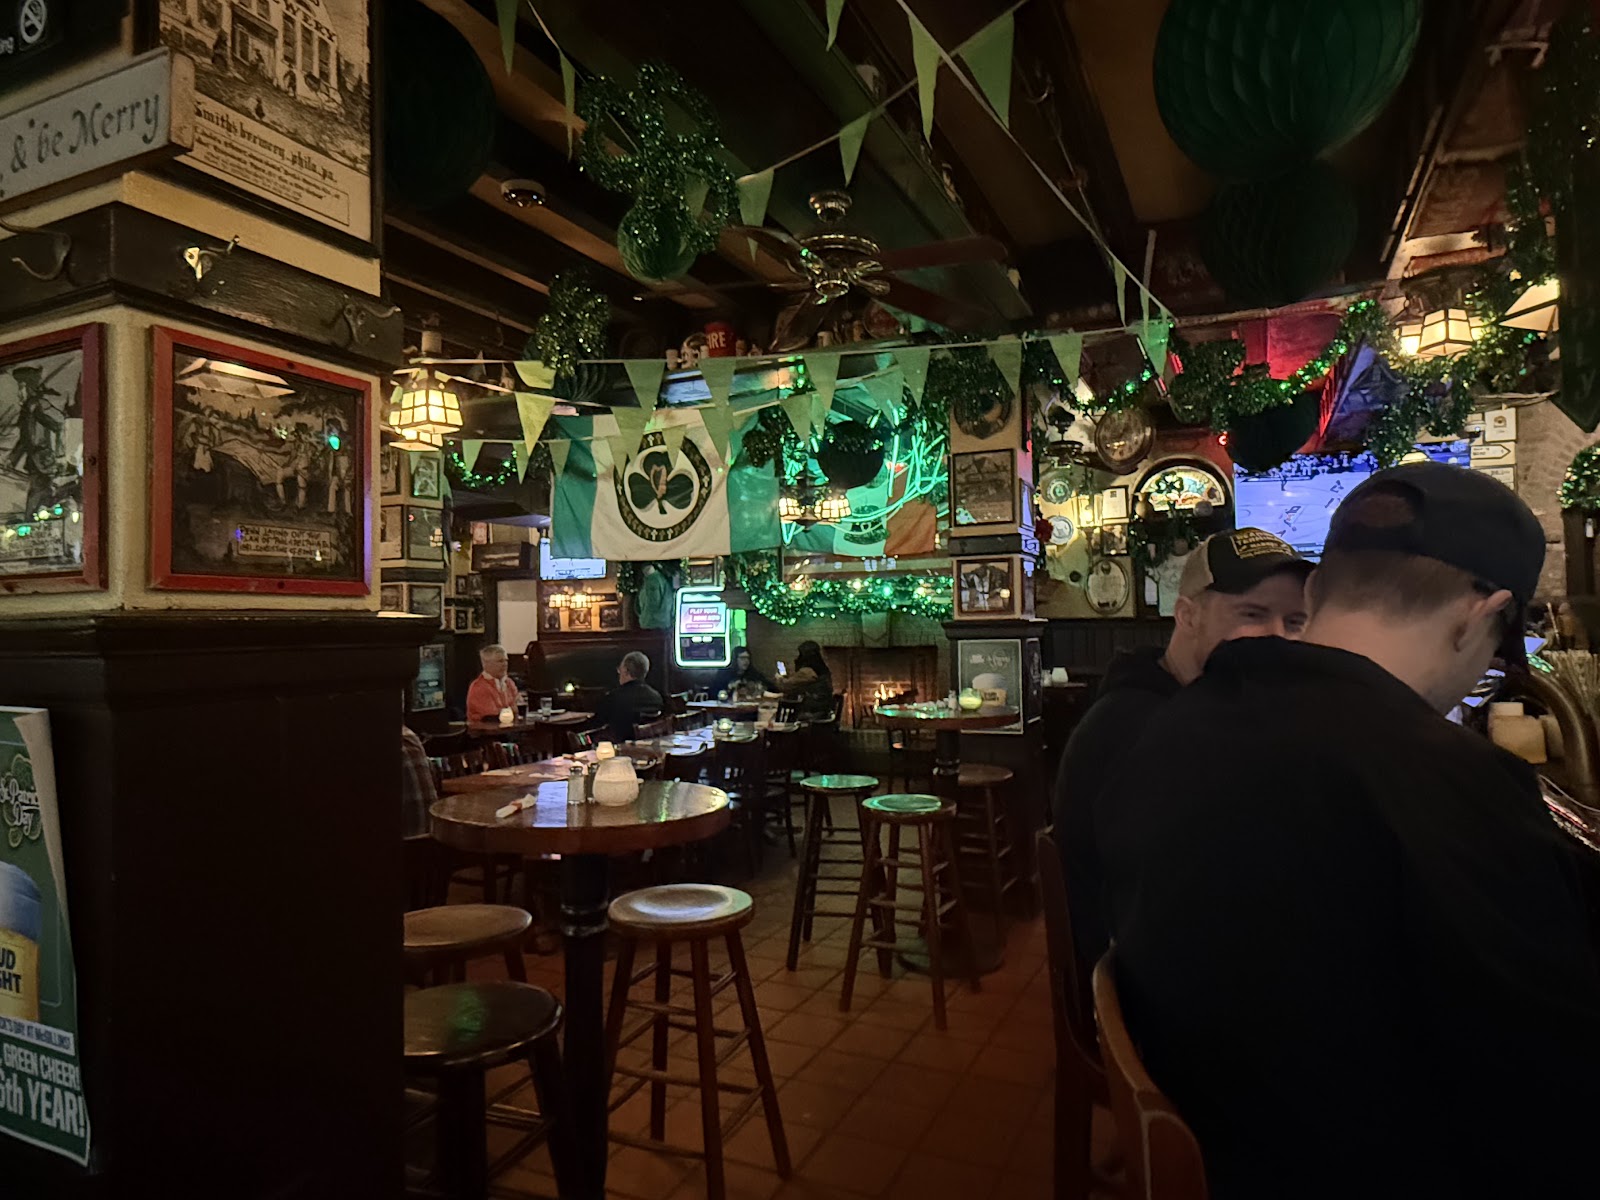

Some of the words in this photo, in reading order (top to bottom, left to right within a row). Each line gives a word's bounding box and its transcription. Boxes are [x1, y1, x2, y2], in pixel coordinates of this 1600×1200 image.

[11, 135, 27, 173] &
[69, 94, 159, 154] Merry
[3, 1043, 38, 1077] GREEN
[39, 1054, 80, 1091] CHEER!
[27, 1077, 85, 1138] YEAR!
